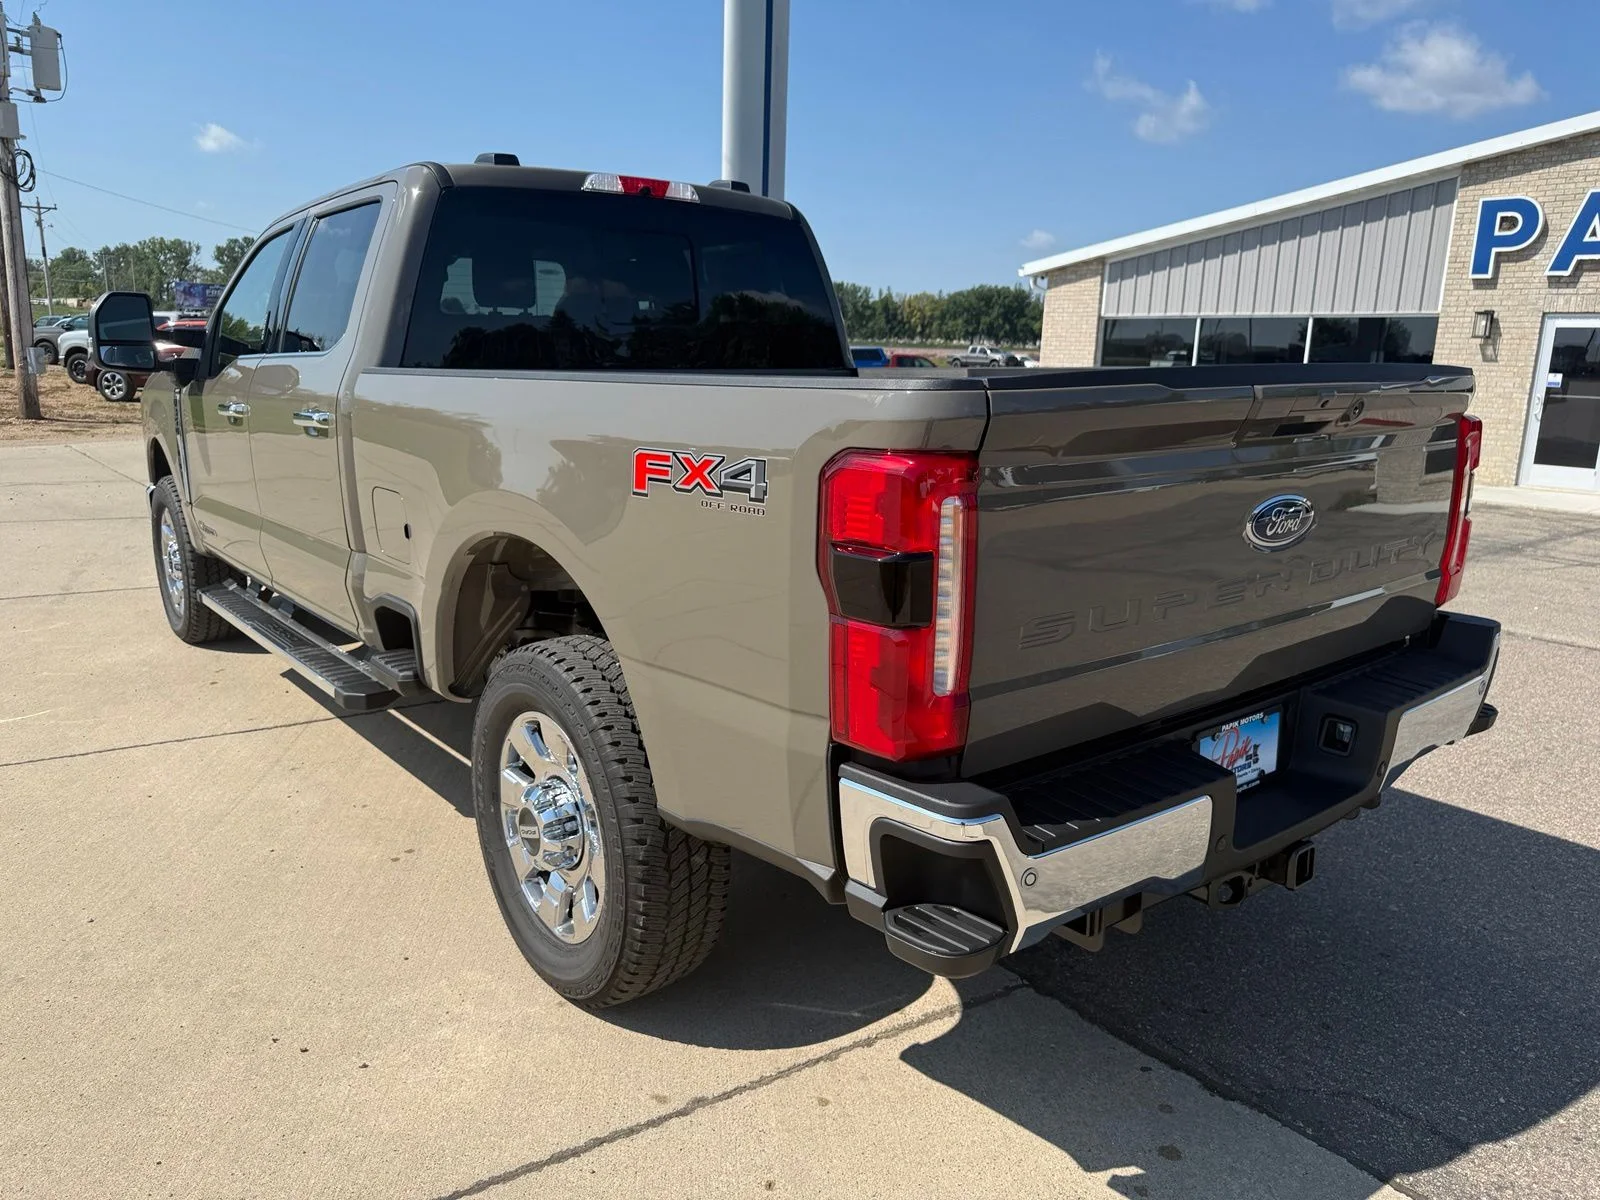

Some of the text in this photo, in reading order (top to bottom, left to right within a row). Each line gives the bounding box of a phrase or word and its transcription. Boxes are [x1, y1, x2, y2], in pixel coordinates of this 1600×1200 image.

[1469, 187, 1600, 279] PA
[631, 447, 768, 504] FX4
[701, 500, 766, 516] OFF ROAD
[1266, 506, 1305, 536] Ford
[1018, 531, 1436, 650] SUPER DUTY
[1221, 712, 1264, 732] PAPIK MOTORS
